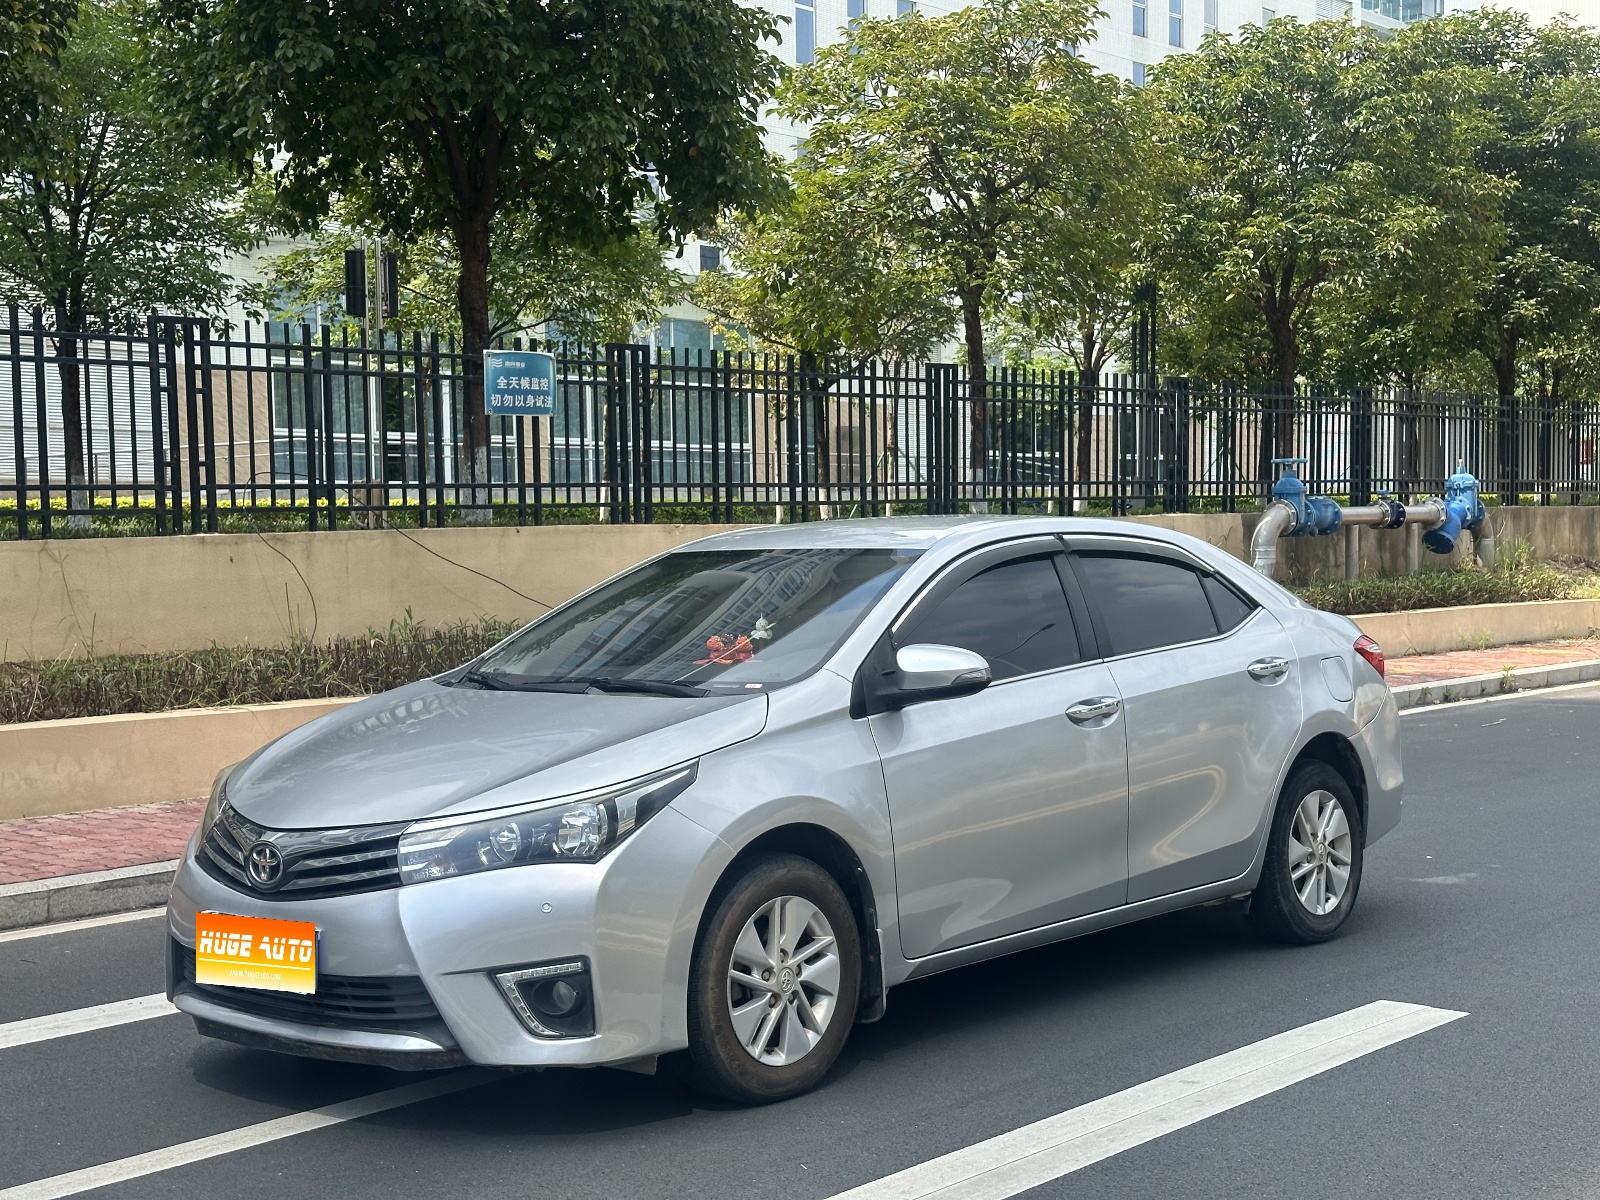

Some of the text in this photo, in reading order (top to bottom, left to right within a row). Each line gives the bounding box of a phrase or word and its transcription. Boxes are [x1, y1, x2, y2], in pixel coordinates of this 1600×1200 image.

[497, 376, 549, 390] 全天候监控
[491, 394, 553, 408] 切勿以身试法
